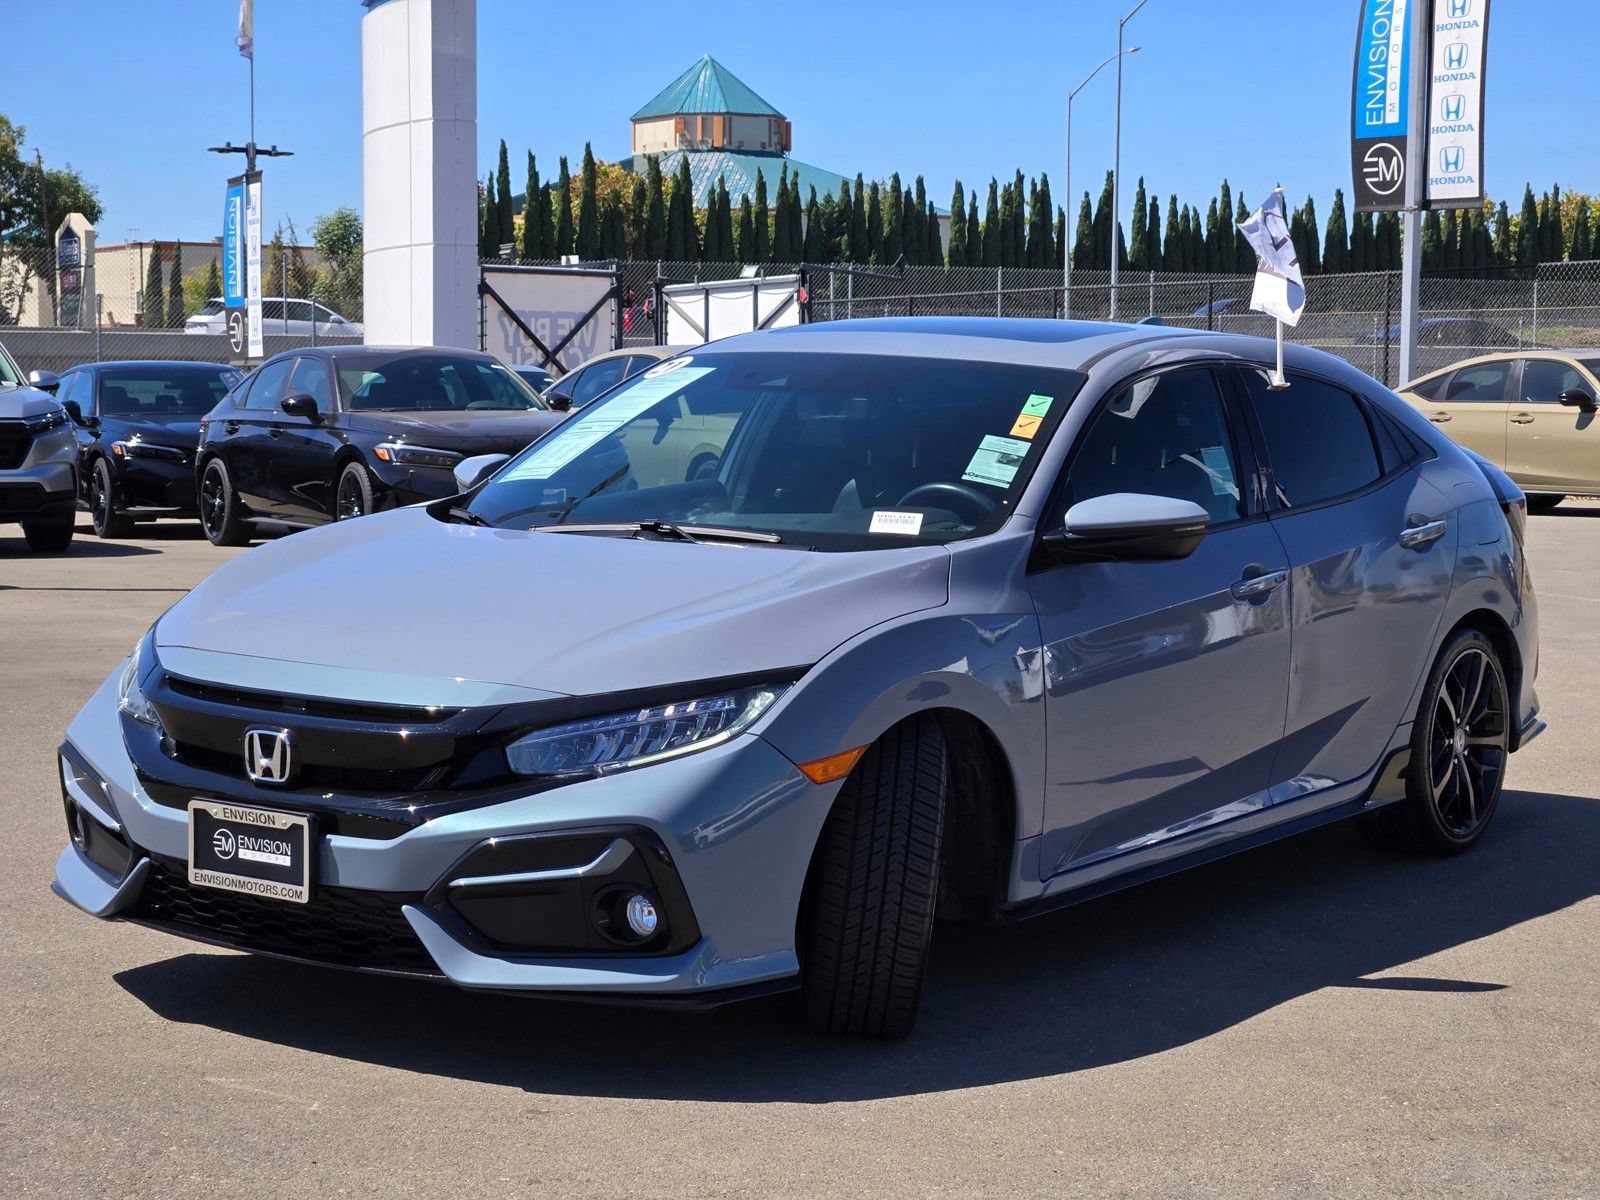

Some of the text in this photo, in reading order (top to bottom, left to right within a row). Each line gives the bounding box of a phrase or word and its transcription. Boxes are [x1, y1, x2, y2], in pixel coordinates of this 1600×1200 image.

[1436, 20, 1480, 32] HONDA
[1366, 0, 1393, 126] ENVISION
[1388, 7, 1403, 113] MOTORS
[1434, 72, 1477, 83] HONDA
[1432, 124, 1475, 134] HONDA
[1430, 175, 1474, 186] HONDA
[228, 197, 237, 298] ENVISION
[223, 807, 276, 826] ENVISION
[238, 835, 291, 856] ENVISION
[194, 872, 303, 901] ENVISIONMOTORS.COM
